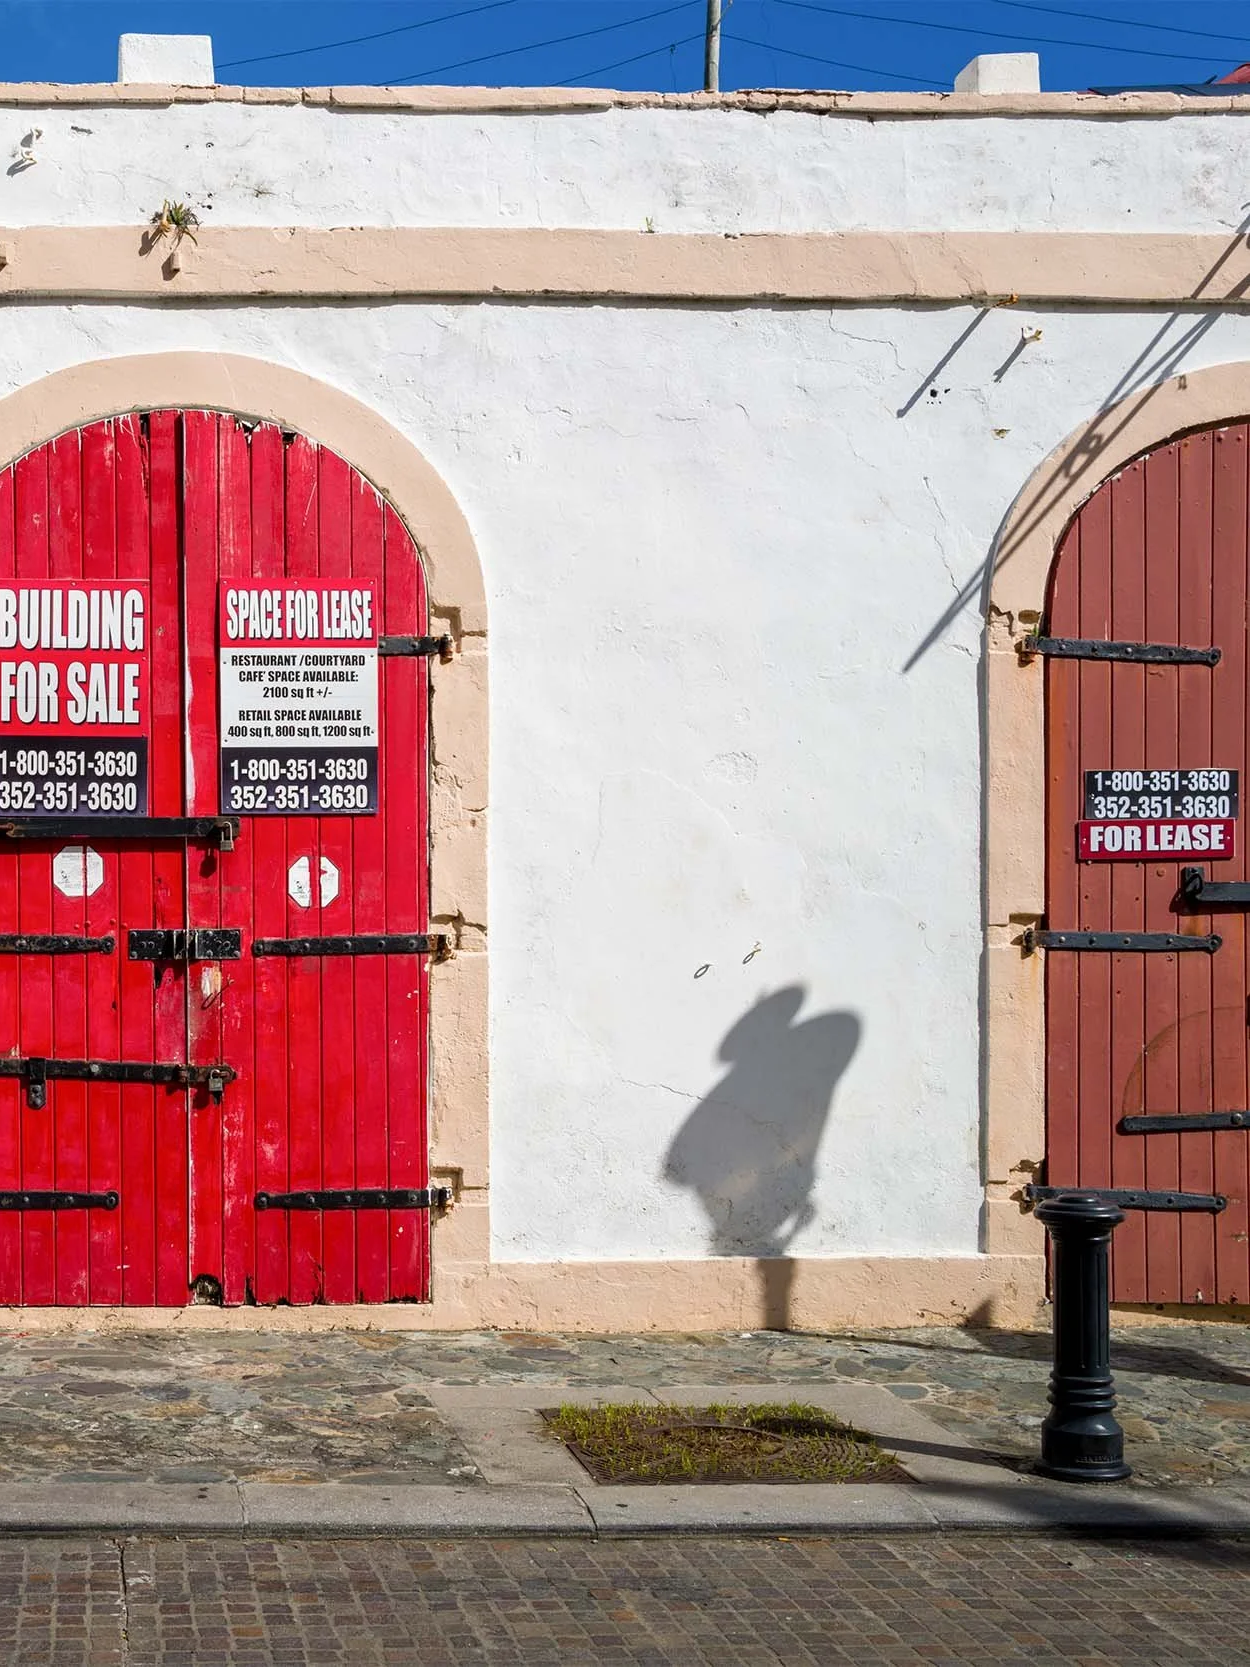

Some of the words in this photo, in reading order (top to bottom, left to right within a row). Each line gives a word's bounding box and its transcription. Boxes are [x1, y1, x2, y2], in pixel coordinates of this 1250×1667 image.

[226, 589, 283, 639] SPACE
[286, 589, 319, 639] FOR
[322, 589, 373, 639] LEASE
[268, 671, 301, 682] SPACE
[302, 671, 359, 682] AVAILABLE:
[0, 661, 59, 723] FOR
[67, 661, 140, 724] SALE
[263, 687, 289, 698] 2100
[291, 690, 304, 700] sq
[306, 687, 314, 698] ft
[316, 687, 333, 698] +/-
[239, 710, 272, 721] RETAIL
[274, 710, 307, 721] SPACE
[308, 710, 362, 721] AVAILABLE
[228, 726, 248, 737] 400
[250, 728, 262, 738] sq
[264, 726, 274, 738] ft,
[275, 726, 295, 737] 800
[299, 728, 310, 738] sq
[311, 726, 321, 738] ft,
[323, 726, 347, 737] 1200
[349, 728, 361, 738] sq
[0, 750, 137, 776] 1-800-351-3630
[230, 758, 368, 781] 1-800-351-3630
[1094, 771, 1230, 792] 1-800-351-3630
[230, 784, 368, 809] 352-351-3630
[1094, 796, 1230, 819] 352-351-3630
[1090, 826, 1142, 852] FOR
[1146, 824, 1225, 851] LEASE
